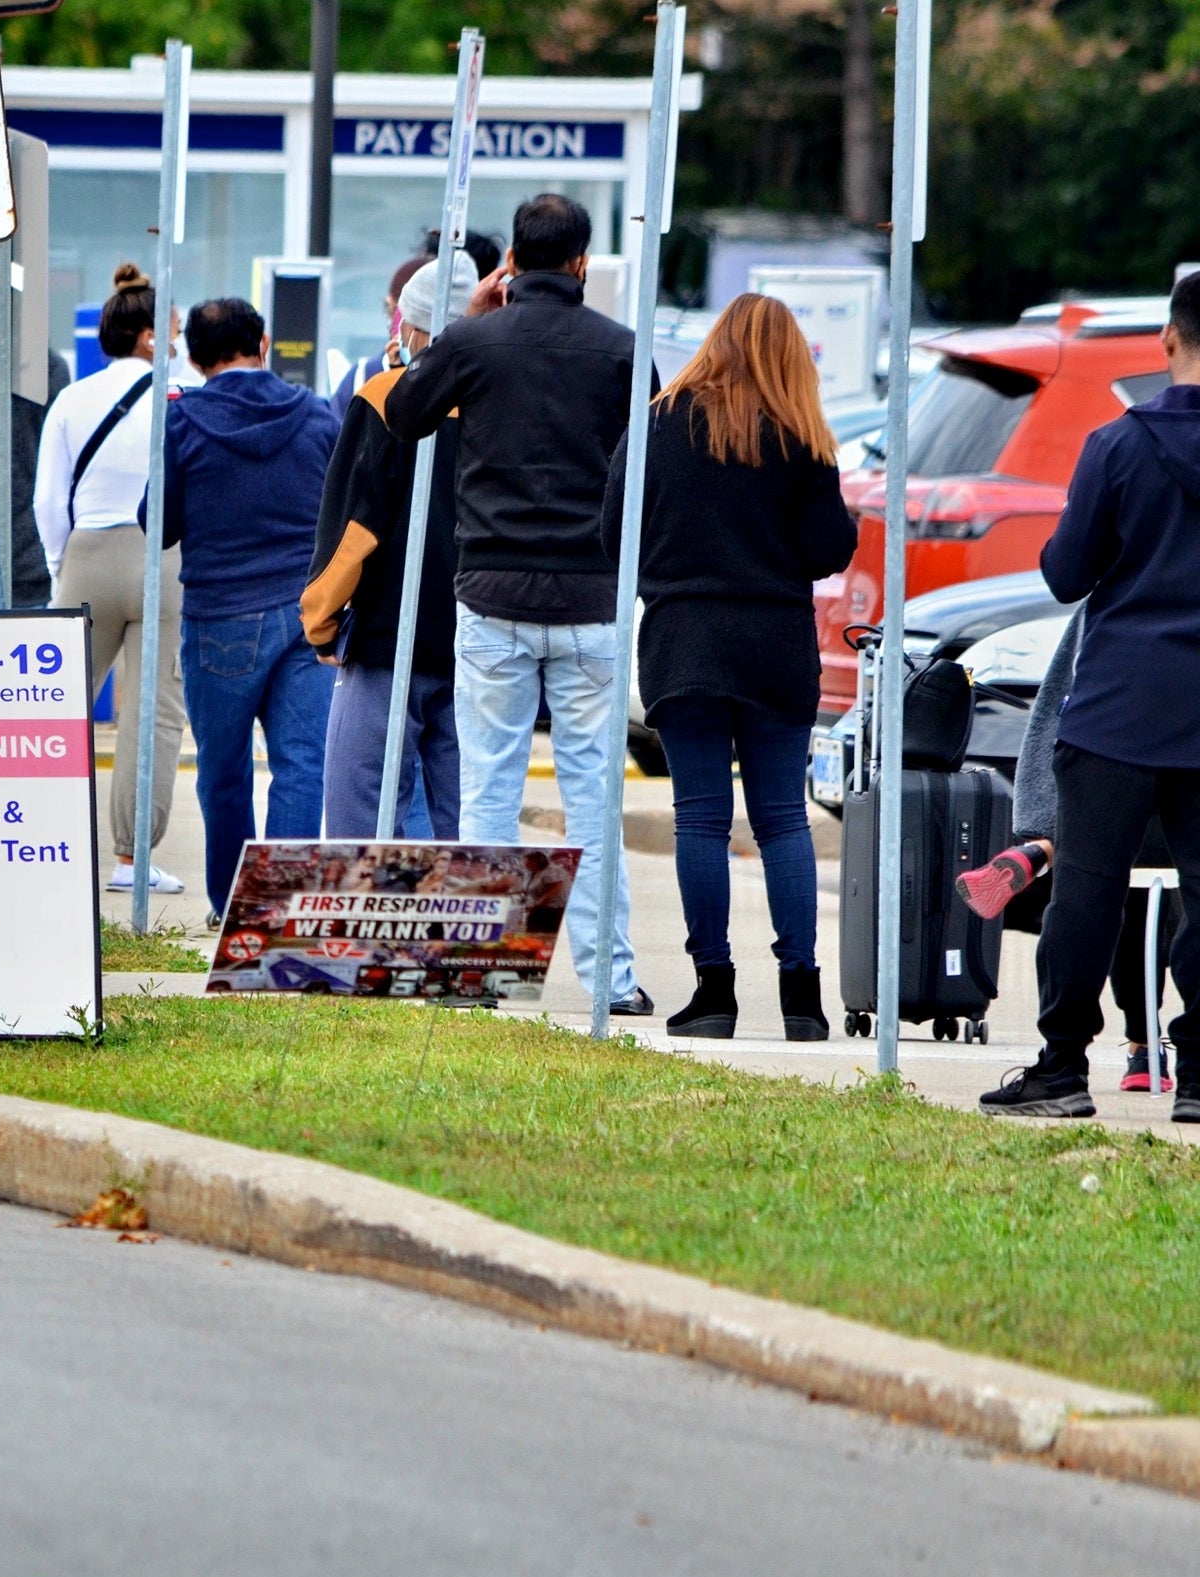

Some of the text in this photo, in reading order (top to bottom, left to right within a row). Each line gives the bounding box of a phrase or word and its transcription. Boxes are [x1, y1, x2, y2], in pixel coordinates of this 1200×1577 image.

[354, 121, 586, 158] PAY SATION
[3, 800, 24, 824] &
[1, 839, 71, 863] Tent
[299, 895, 501, 916] FIRST RESPONDERS
[294, 919, 495, 942] WE THANK YOU
